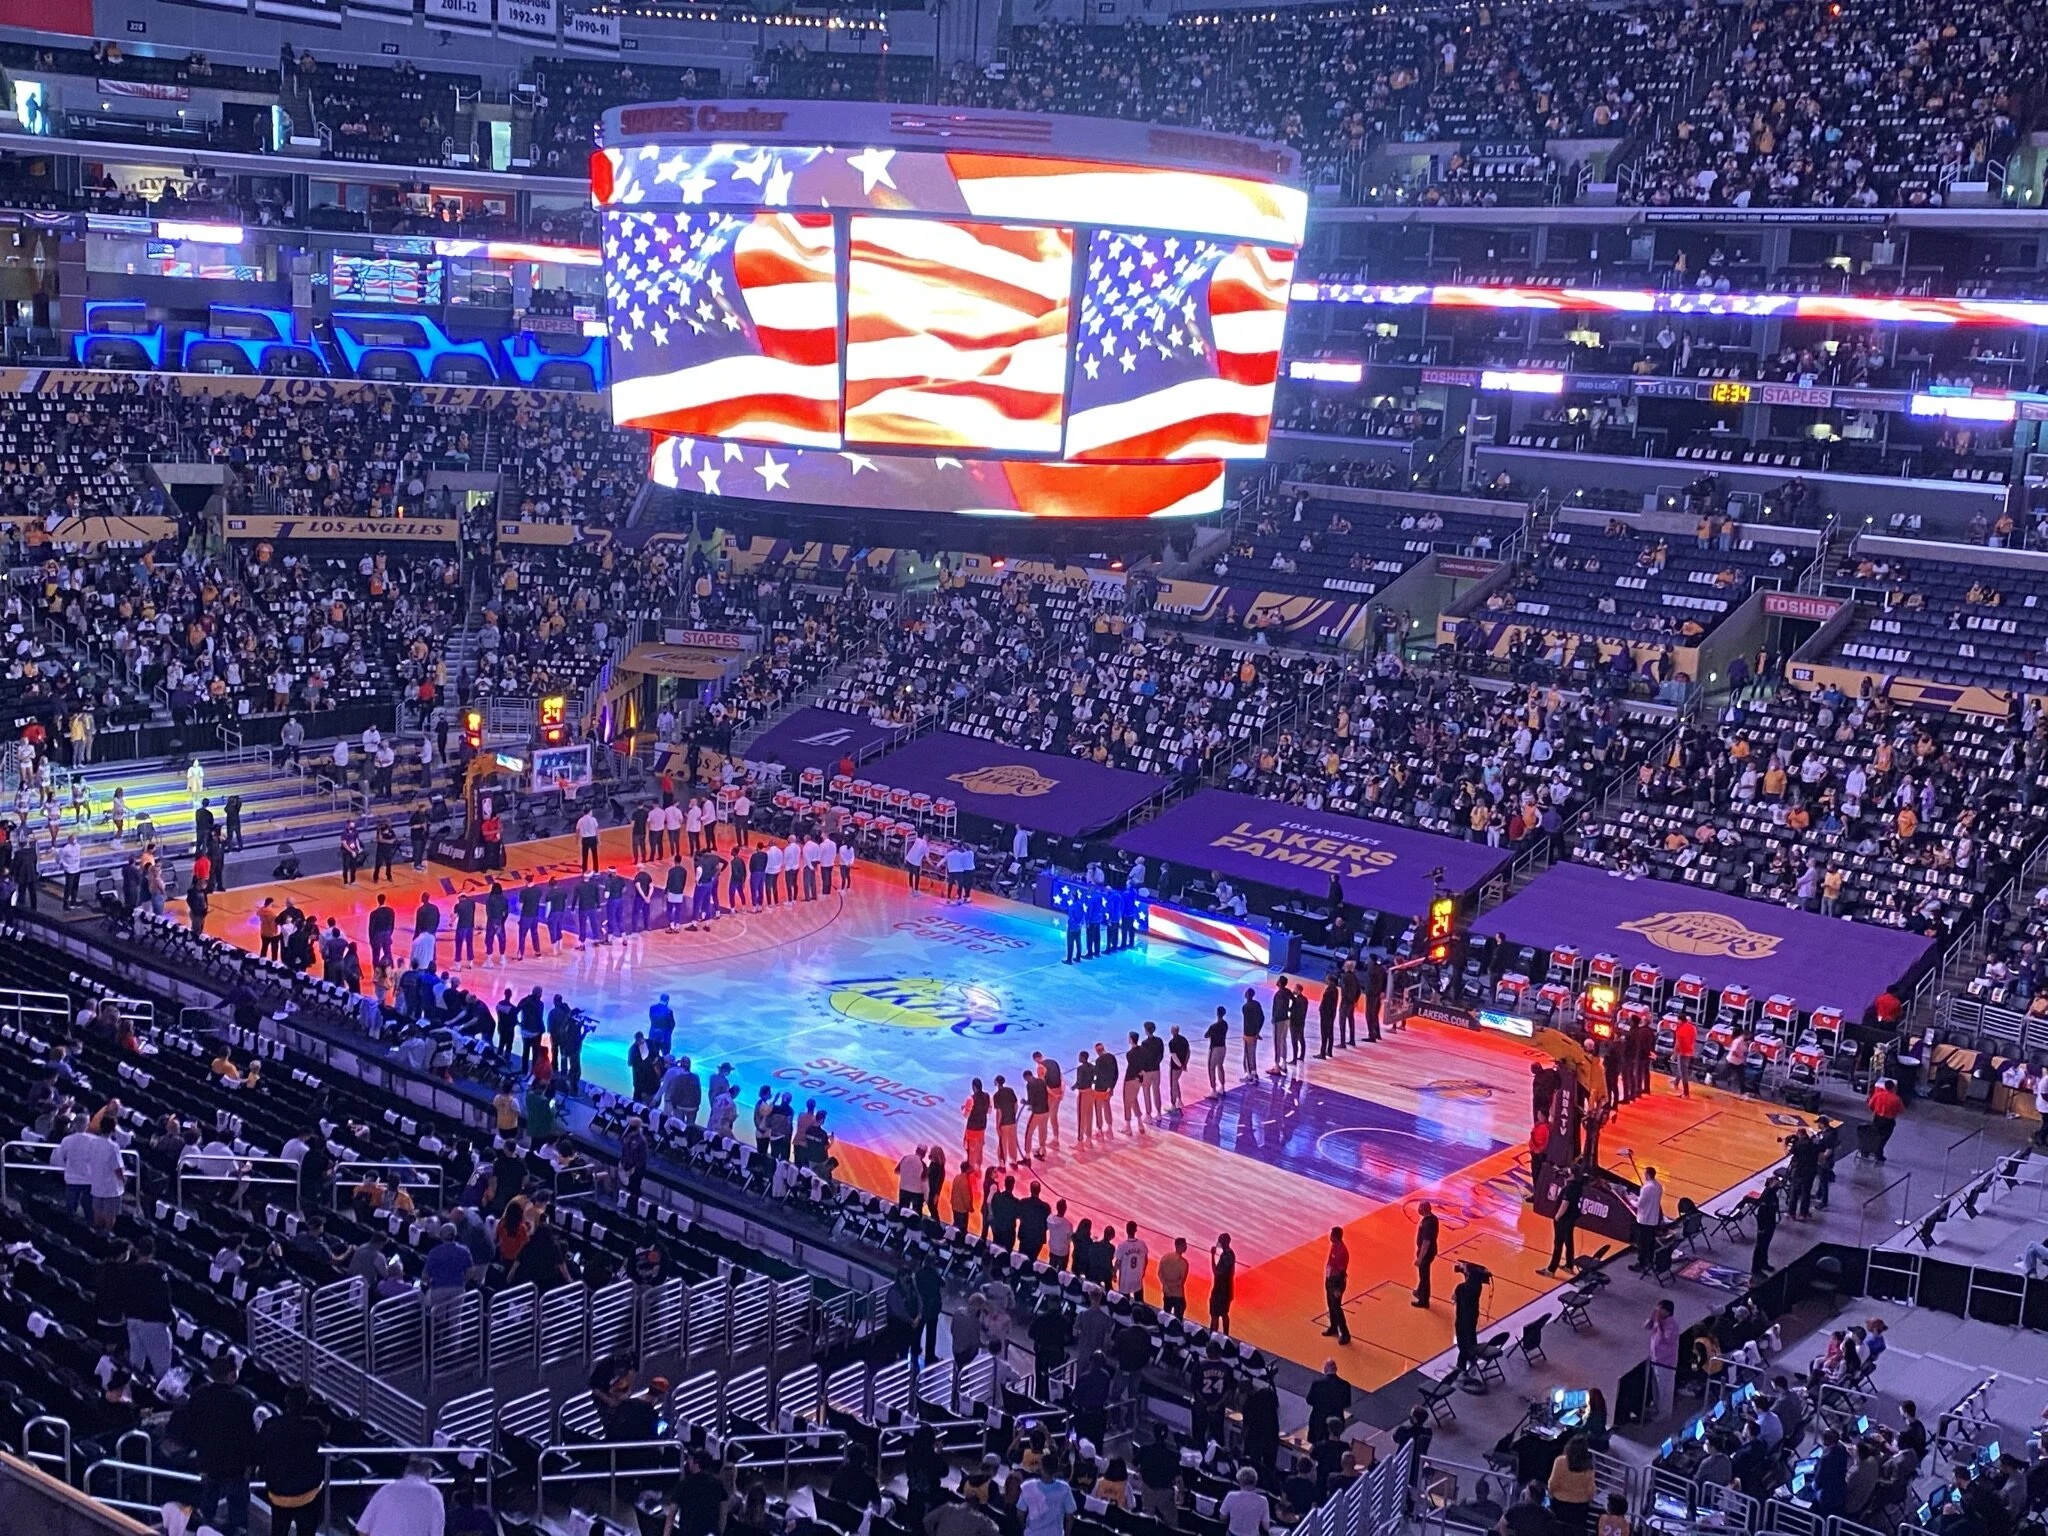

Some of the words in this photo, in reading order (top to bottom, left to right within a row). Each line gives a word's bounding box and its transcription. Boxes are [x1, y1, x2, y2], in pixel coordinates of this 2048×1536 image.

[440, 0, 477, 13] 2011-12
[508, 7, 546, 26] 1992-93
[574, 17, 610, 36] 1990-91
[697, 105, 788, 131] Center
[1485, 144, 1531, 156] DELTA
[522, 319, 576, 333] STAPLES
[1422, 371, 1476, 385] TOSHIBA
[1576, 381, 1592, 390] BUD
[1594, 381, 1619, 391] LIGHT
[1648, 383, 1691, 396] DELTA
[1711, 384, 1751, 402] 12:34
[1763, 387, 1828, 405] STAPLES
[307, 521, 346, 533] LOS
[347, 522, 446, 536] ANGELES
[1766, 597, 1837, 617] TOSHIBA
[682, 631, 740, 648] STAPLES
[542, 707, 561, 724] 24
[1279, 821, 1309, 833] LOS
[1307, 826, 1383, 846] ANGELES
[1231, 822, 1398, 867] LAKERS
[1208, 835, 1382, 878] FAMILY
[917, 915, 1032, 950] STAPLES
[1432, 914, 1450, 937] 24
[893, 921, 1005, 955] Center
[1632, 915, 1769, 958] LAKERS
[1417, 1006, 1470, 1029] LAKERS.COM
[804, 1057, 946, 1108] STAPLES
[772, 1067, 913, 1118] Center
[1561, 1089, 1570, 1117] NBA
[1559, 1118, 1568, 1136] TV
[1581, 1198, 1609, 1219] game
[1130, 1256, 1138, 1270] 8
[1202, 1379, 1224, 1394] 24
